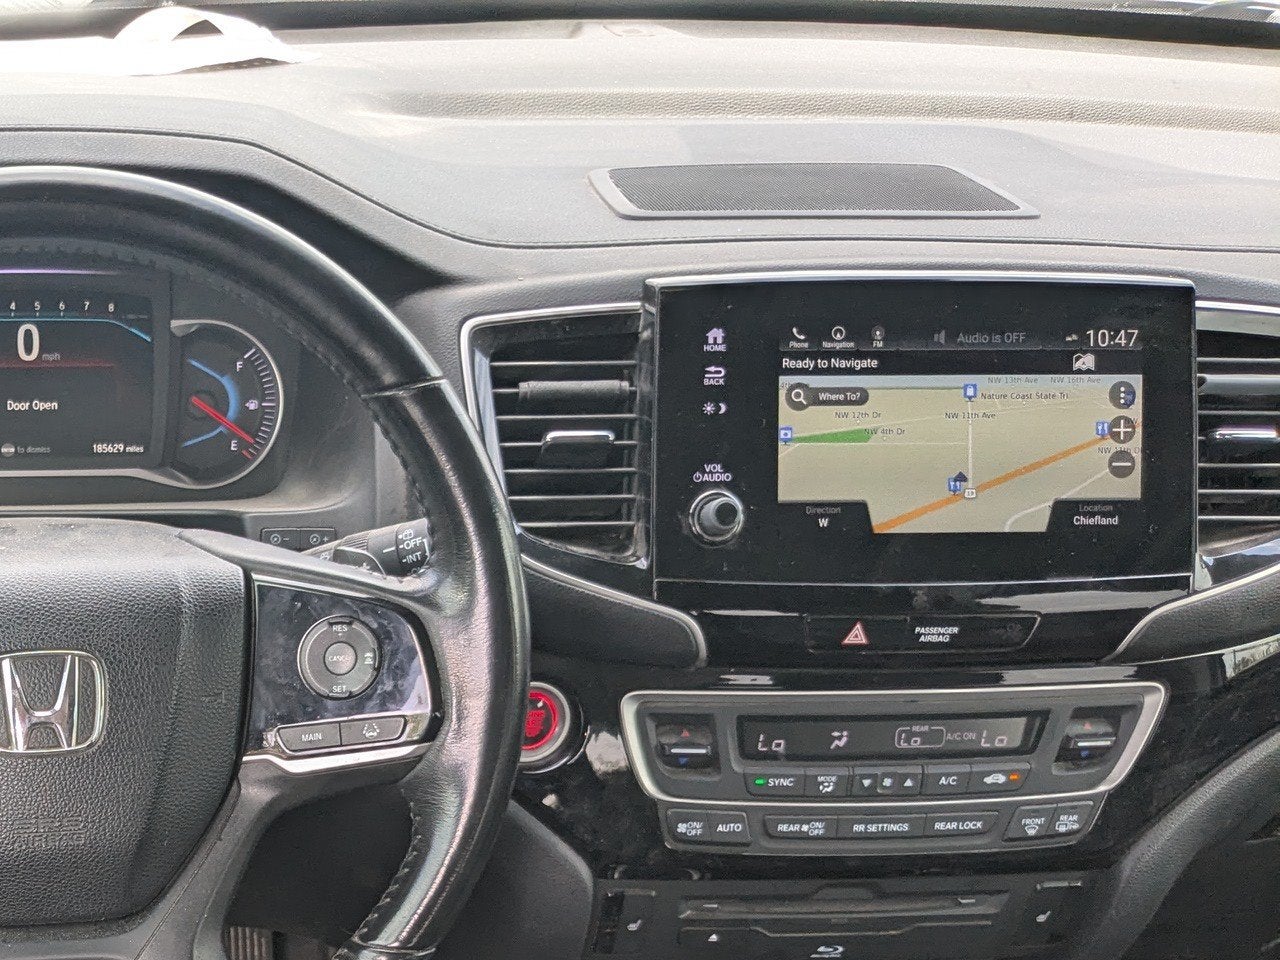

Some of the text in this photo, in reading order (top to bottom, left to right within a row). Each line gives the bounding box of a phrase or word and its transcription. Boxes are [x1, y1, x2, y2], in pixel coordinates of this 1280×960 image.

[9, 302, 17, 311] 4
[33, 302, 41, 311] 5
[58, 302, 66, 311] 6
[83, 302, 91, 311] 7
[107, 303, 115, 313] 8
[17, 323, 61, 362] 0 mph
[957, 332, 1026, 344] Audio is OFF
[1085, 329, 1139, 347] 10:47
[703, 344, 727, 352] HOME
[789, 341, 809, 350] Phone
[822, 341, 855, 350] Navigation
[872, 341, 883, 349] FM
[236, 361, 244, 372] F
[782, 358, 878, 371] Ready to Navigate
[703, 378, 725, 386] BACK
[987, 376, 1002, 384] NW
[1023, 376, 1038, 384] Ave
[1050, 376, 1065, 384] NW
[1087, 376, 1101, 384] Ave
[819, 392, 861, 401] Where To?
[980, 392, 1008, 400] Nature
[1010, 392, 1033, 401] Coast
[1035, 392, 1056, 401] State
[7, 400, 58, 413] Door Open
[834, 411, 849, 419] NW
[872, 411, 881, 419] Dr
[945, 411, 959, 419] NW
[981, 411, 996, 419] Ave
[864, 427, 878, 436] NW
[896, 427, 905, 436] Dr
[92, 443, 144, 454] 185629 miles
[231, 440, 238, 451] E
[704, 464, 724, 473] VOL
[703, 473, 732, 482] AUDIO
[806, 505, 841, 515] Direction
[1079, 504, 1113, 512] Location
[818, 518, 829, 528] W
[1073, 515, 1119, 526] Chiefland
[404, 536, 422, 550] OFF
[406, 552, 421, 564] INT
[915, 626, 959, 635] PASSENGER
[919, 635, 949, 643] AIRBAG
[332, 685, 346, 693] SET
[301, 732, 322, 742] MAIN
[946, 731, 976, 741] A/C ON
[767, 777, 794, 787] SYNC
[938, 775, 957, 786] A/C
[1022, 817, 1045, 825] FRONT
[1059, 814, 1078, 822] REAR
[687, 821, 703, 829] ON/
[716, 823, 742, 832] AUTO
[777, 823, 800, 832] REAR
[809, 821, 825, 829] ON/
[853, 823, 909, 833] RR SETTINGS
[934, 821, 982, 830] REAR LOCK
[686, 828, 703, 836] OFF
[808, 828, 825, 836] OFF
